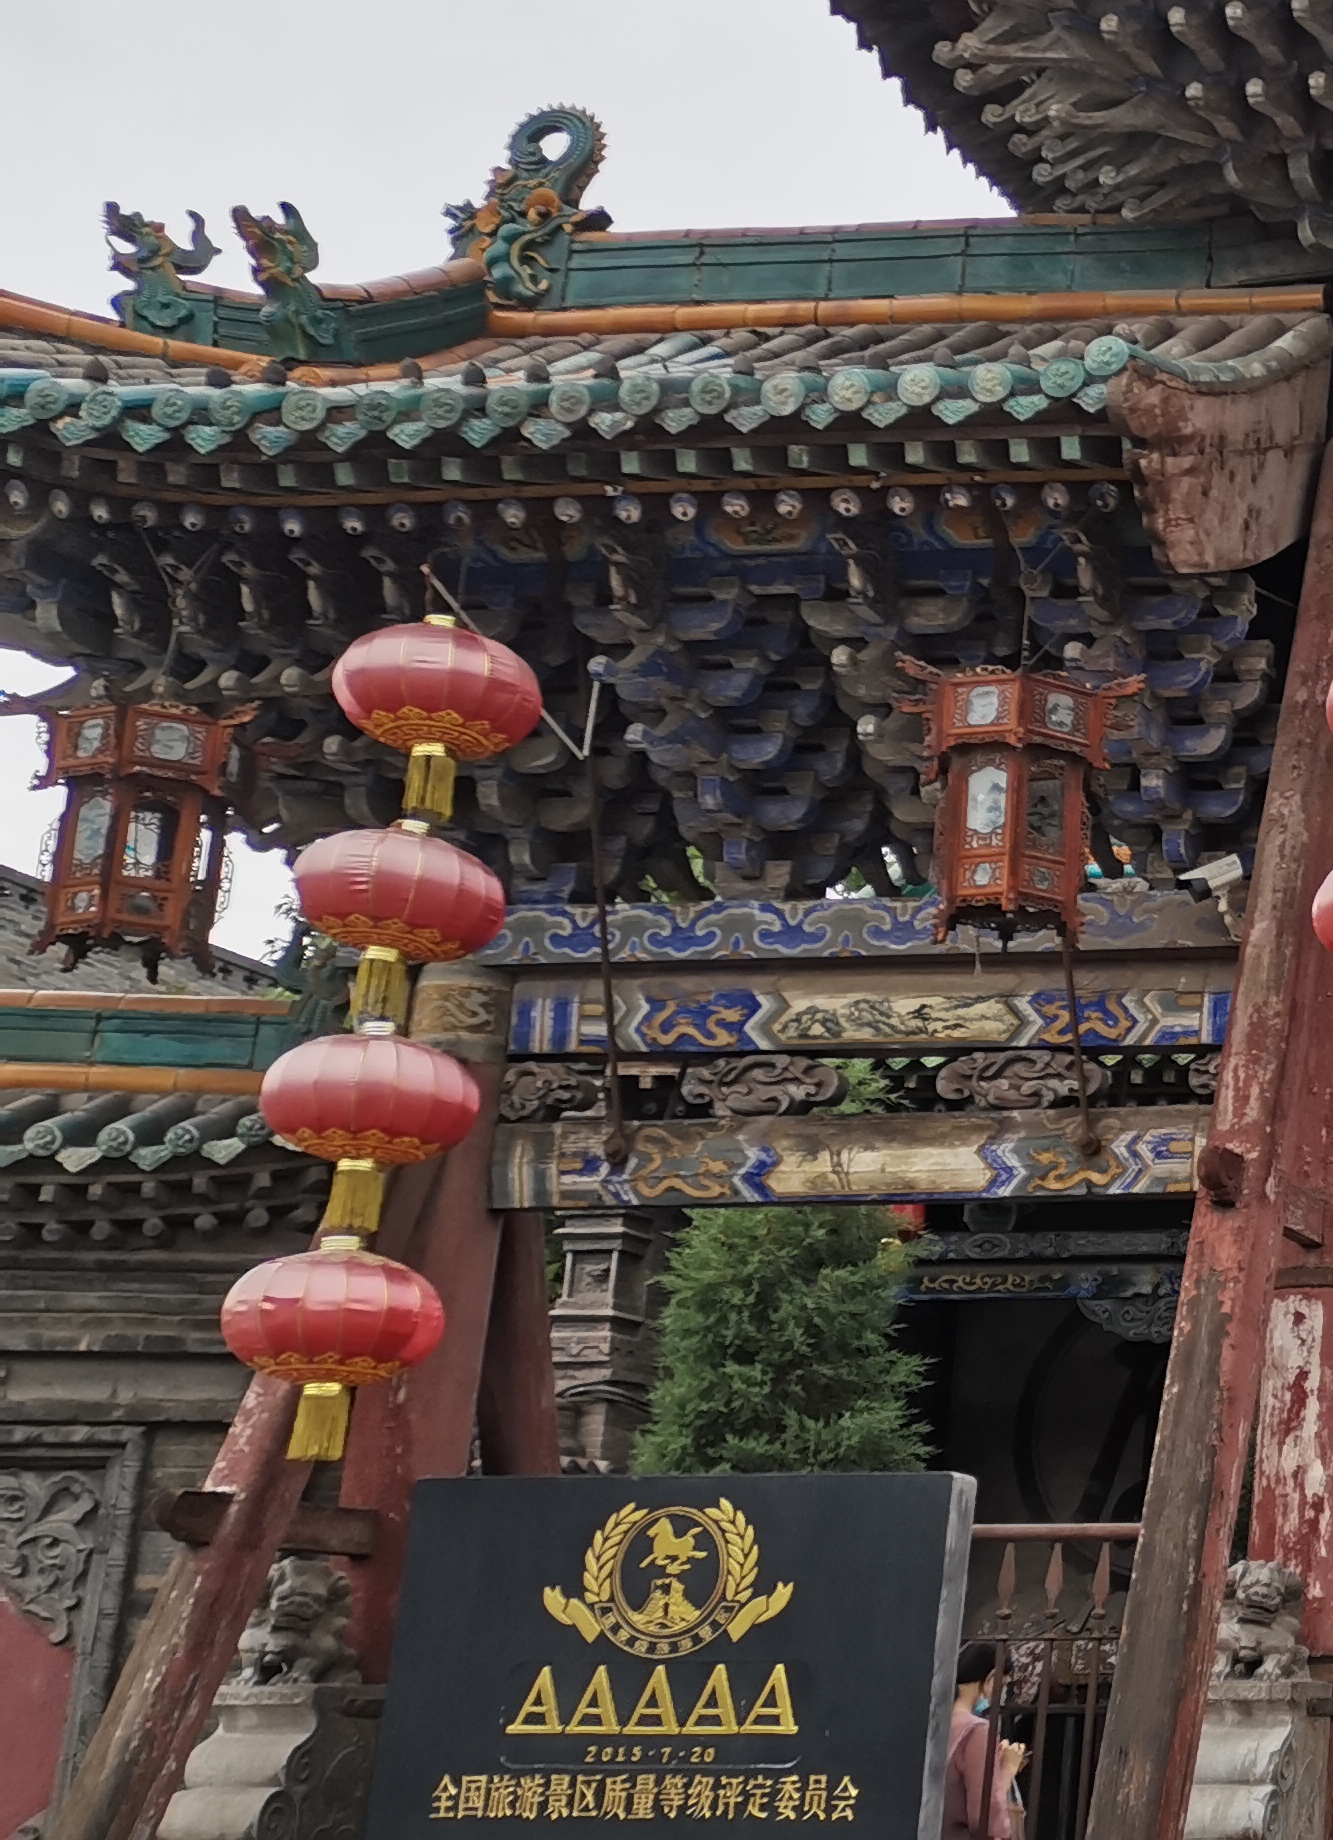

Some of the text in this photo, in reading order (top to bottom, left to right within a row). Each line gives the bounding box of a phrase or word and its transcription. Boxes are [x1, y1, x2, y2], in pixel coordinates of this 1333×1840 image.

[504, 1662, 800, 1735] AAAAA
[428, 1773, 860, 1822] 全国旅游景区质量等级评定委员会
